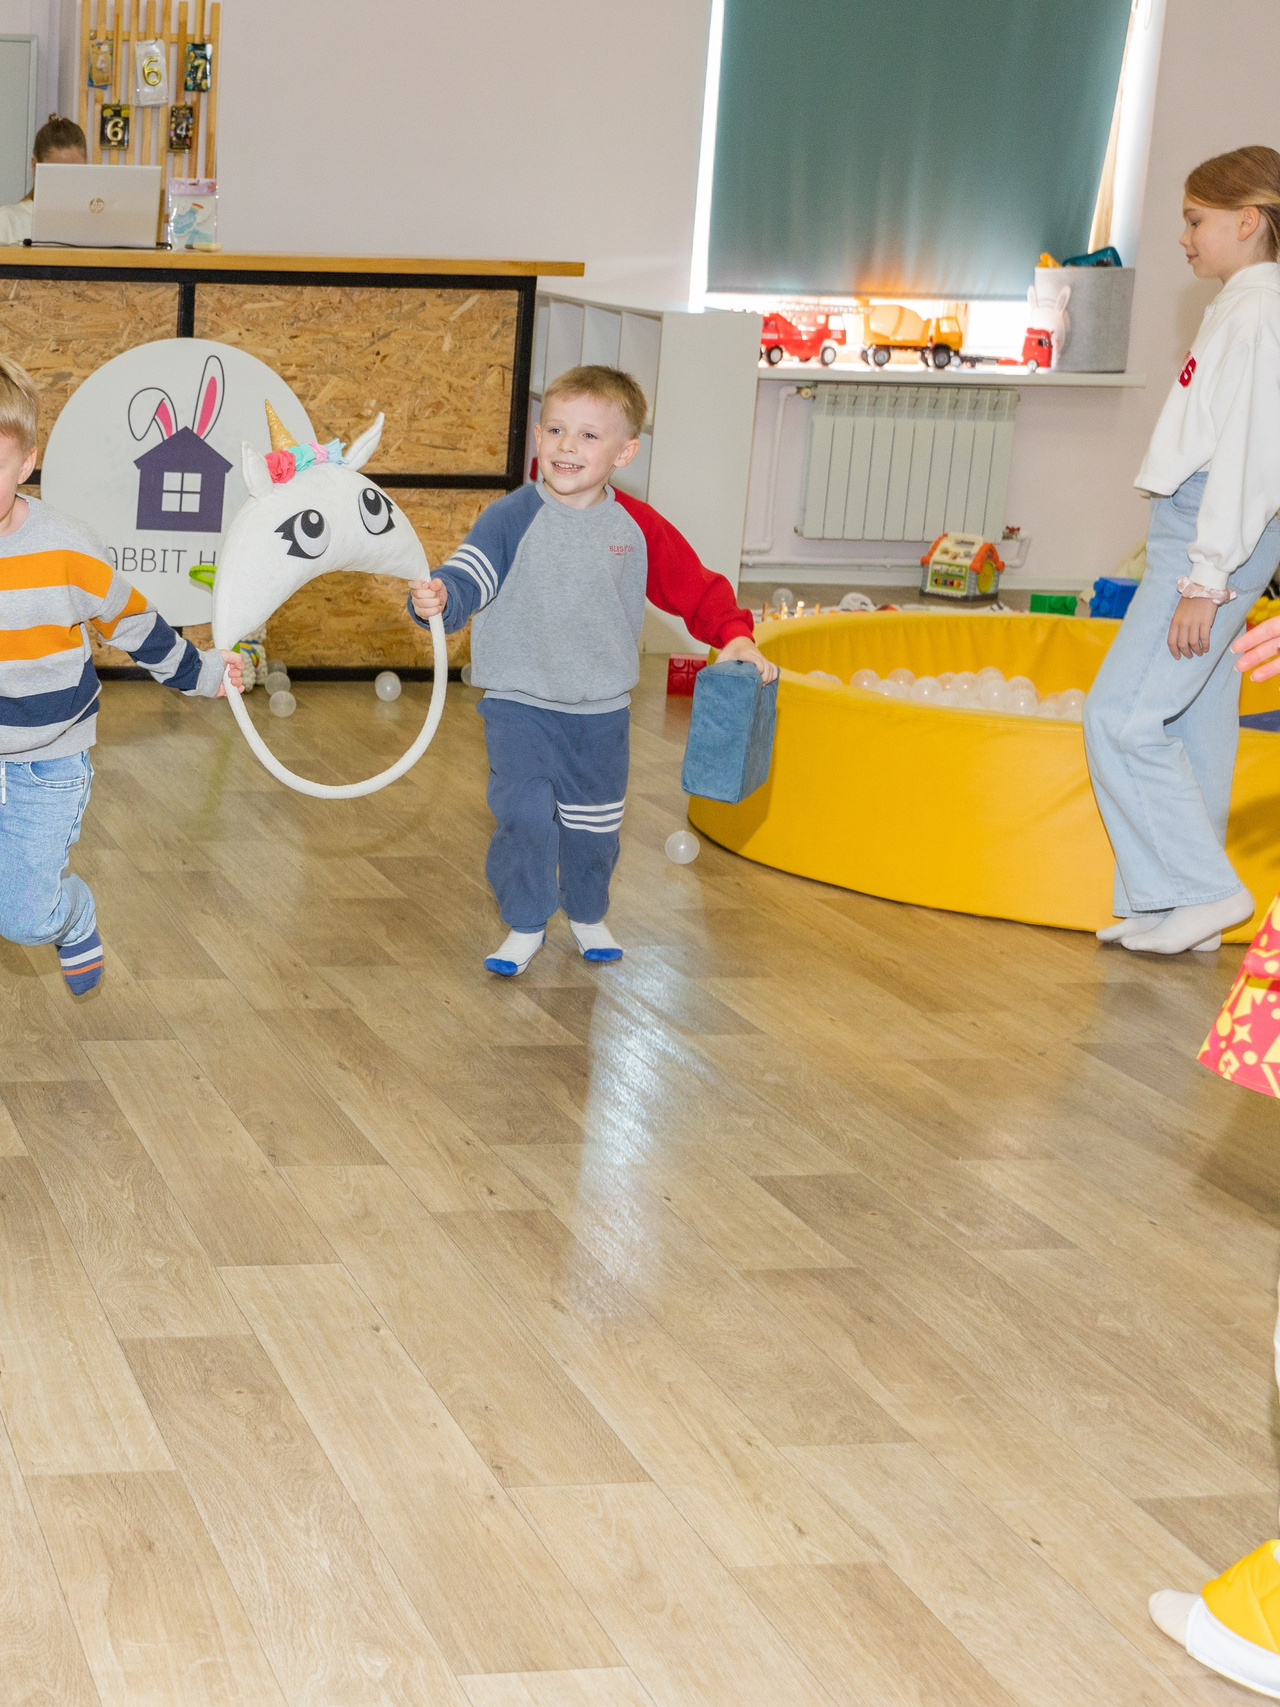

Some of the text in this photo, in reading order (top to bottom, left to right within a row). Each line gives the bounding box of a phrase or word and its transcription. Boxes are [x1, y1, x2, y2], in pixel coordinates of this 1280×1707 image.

[142, 57, 161, 86] 6
[194, 59, 206, 83] 7
[106, 117, 124, 142] 6
[177, 121, 187, 138] 4
[108, 546, 187, 573] ABBIT
